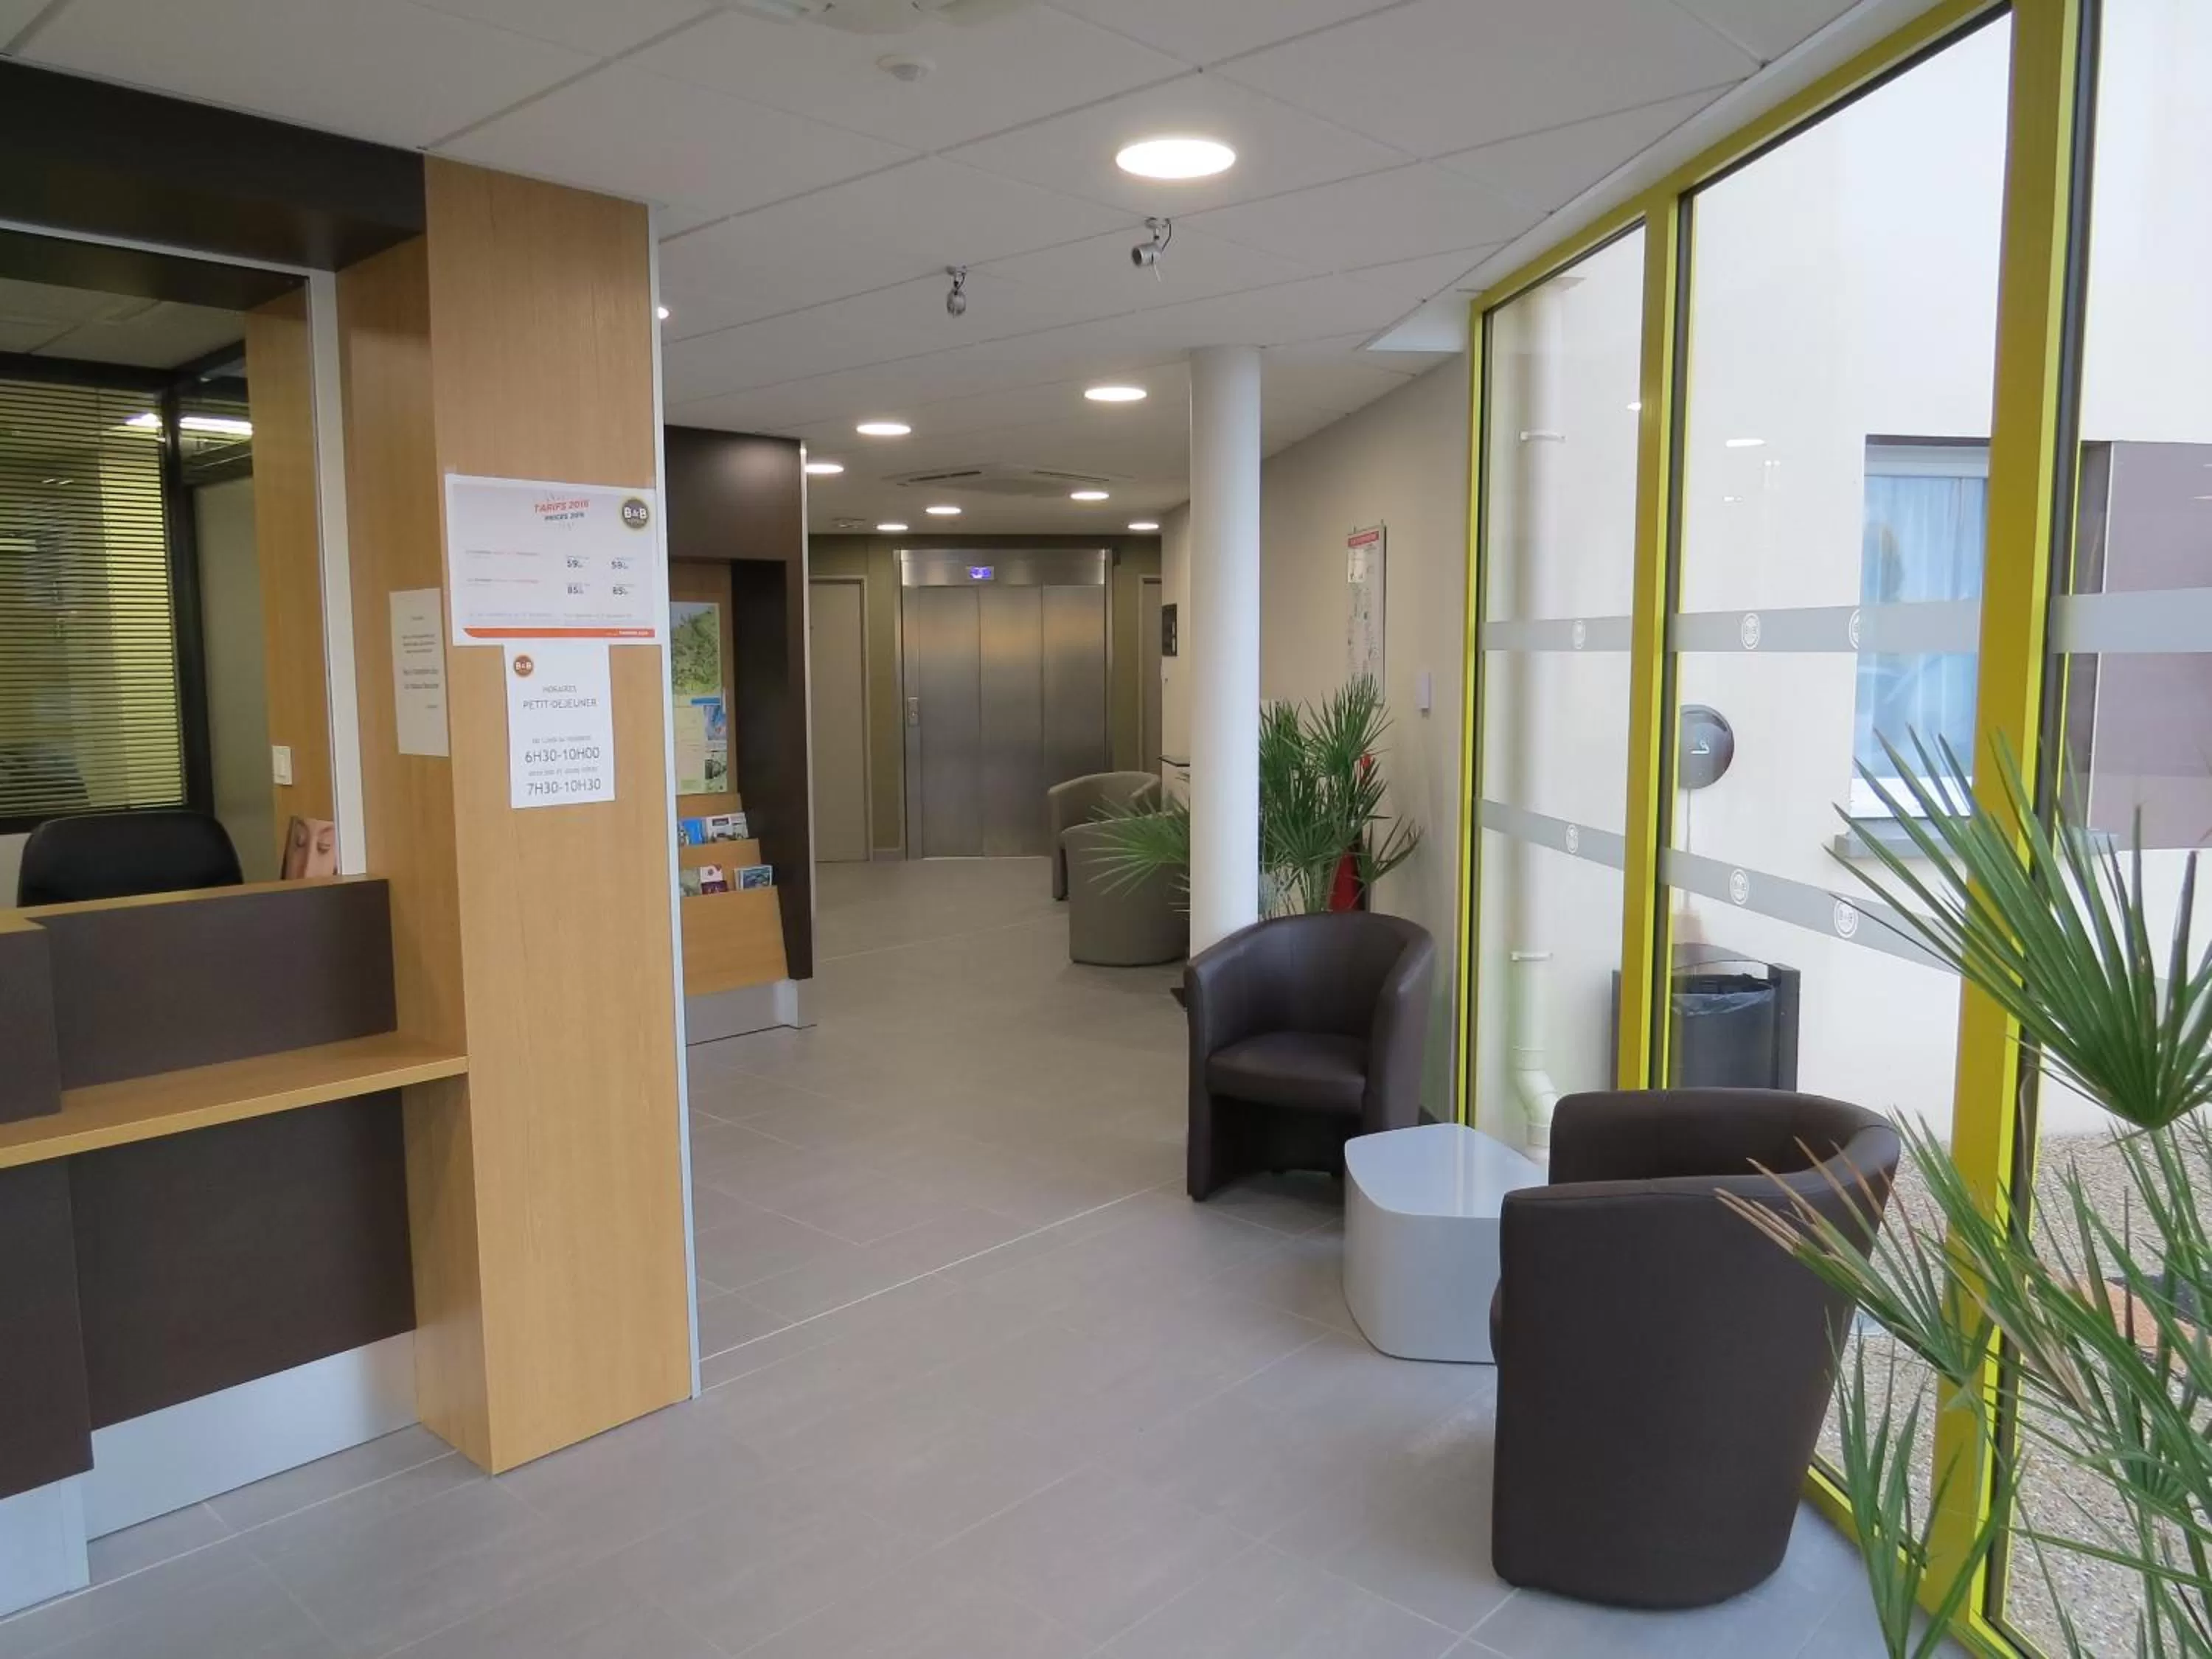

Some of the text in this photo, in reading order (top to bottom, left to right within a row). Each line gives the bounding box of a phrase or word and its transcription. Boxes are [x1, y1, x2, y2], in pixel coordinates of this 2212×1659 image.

[534, 501, 566, 513] TARIFS
[624, 507, 647, 519] B&B
[524, 746, 600, 763] 6H30-10H00
[526, 778, 602, 796] 7H30-10H30
